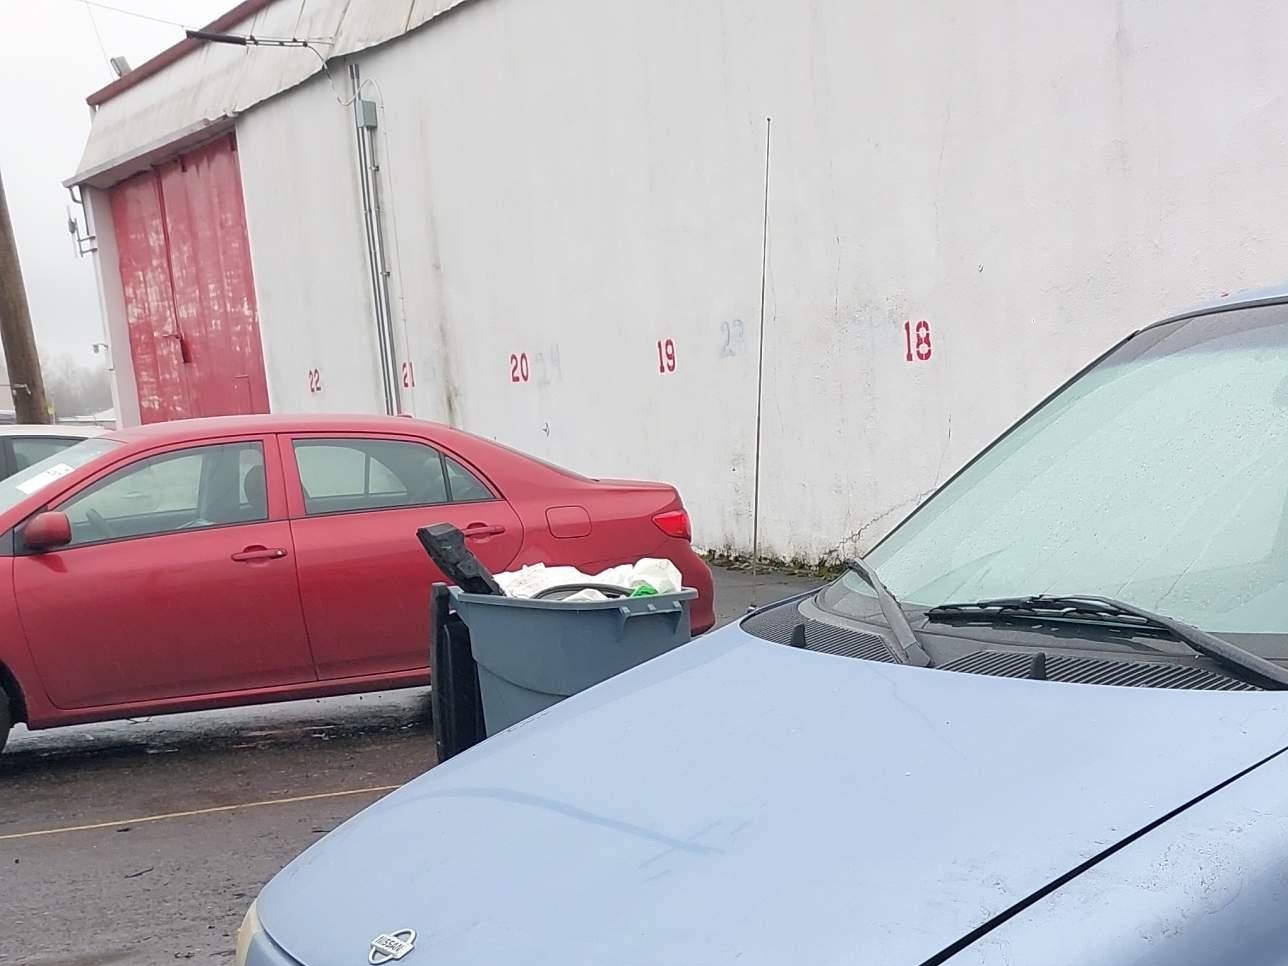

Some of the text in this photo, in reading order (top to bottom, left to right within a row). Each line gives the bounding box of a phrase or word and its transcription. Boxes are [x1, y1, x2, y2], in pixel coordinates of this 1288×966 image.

[904, 320, 932, 361] 18
[510, 353, 529, 382] 20
[657, 339, 676, 373] 19
[308, 369, 321, 392] 22
[402, 362, 415, 388] 21
